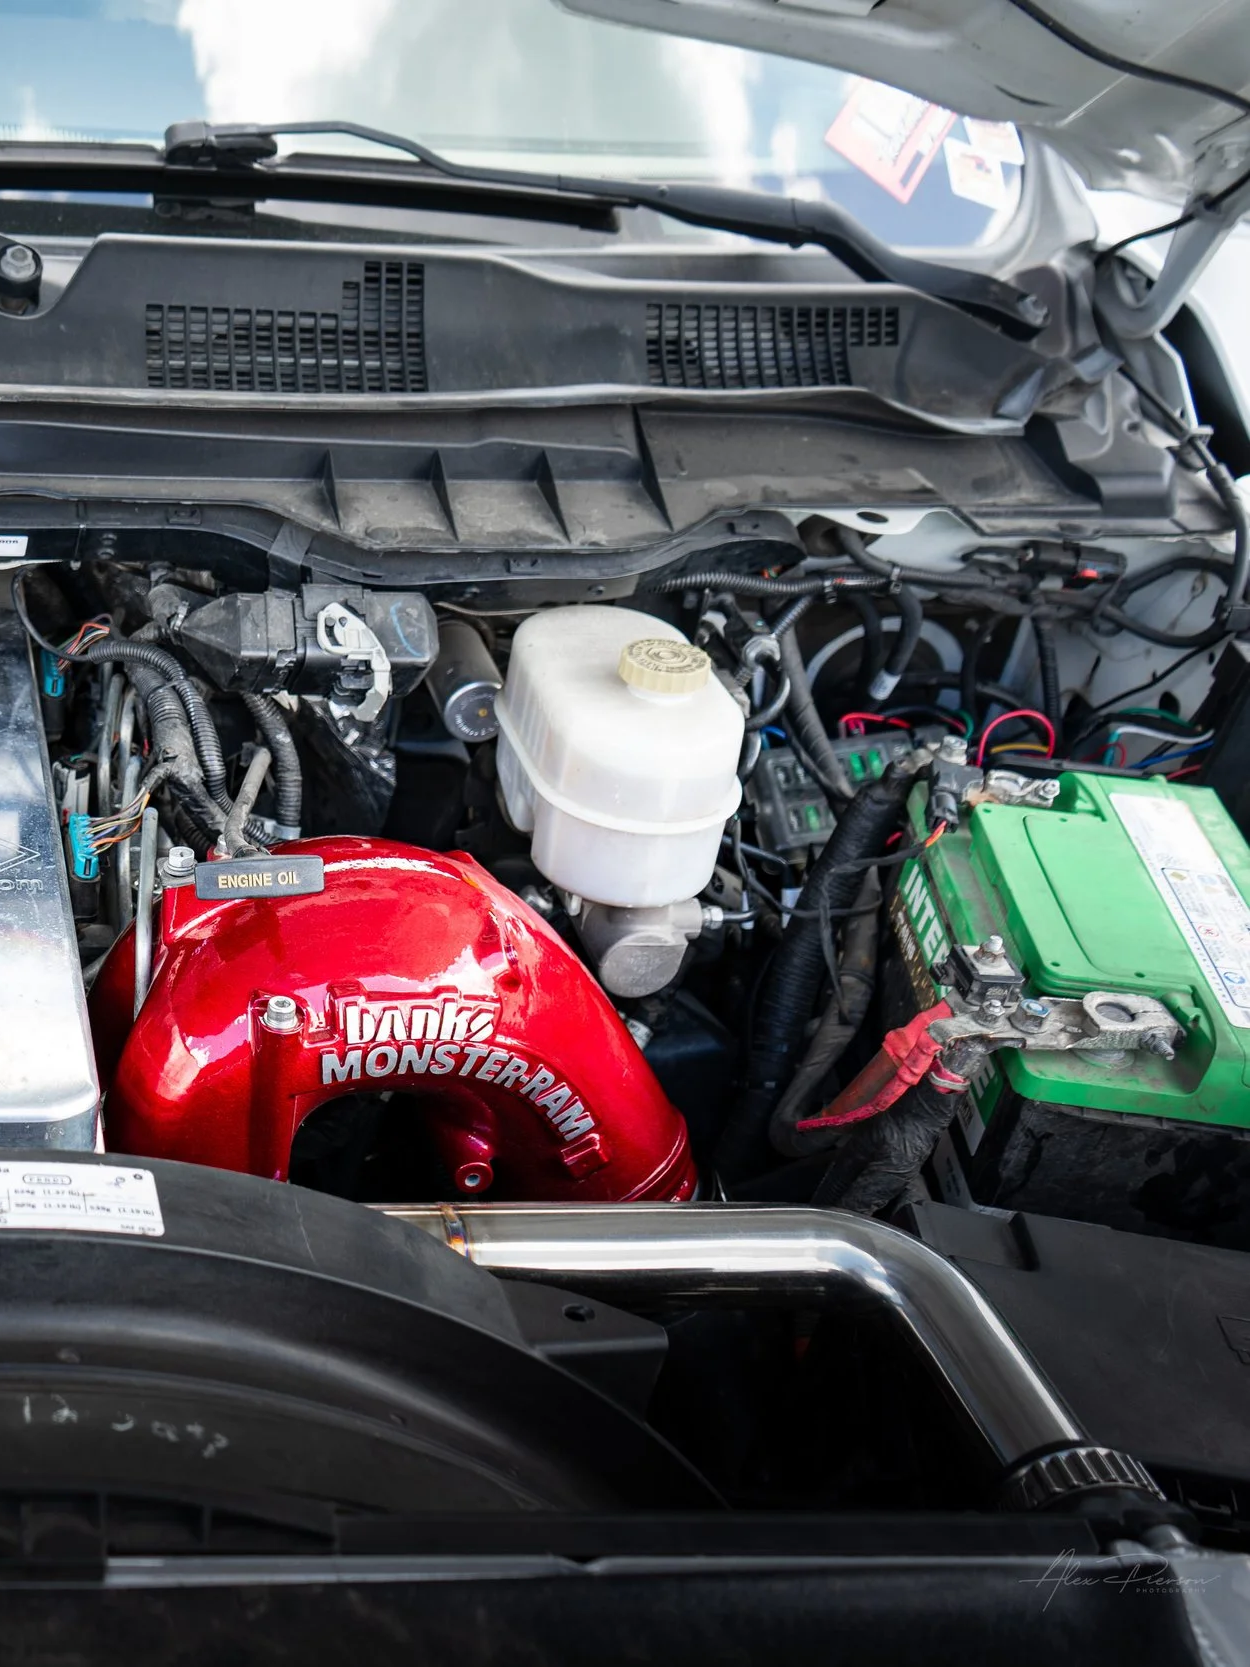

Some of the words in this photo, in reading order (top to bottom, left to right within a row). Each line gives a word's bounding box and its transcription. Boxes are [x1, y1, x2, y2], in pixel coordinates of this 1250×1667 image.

[217, 872, 273, 889] ENGINE
[277, 871, 301, 885] OIL
[321, 1043, 595, 1142] MONSTER-RAM
